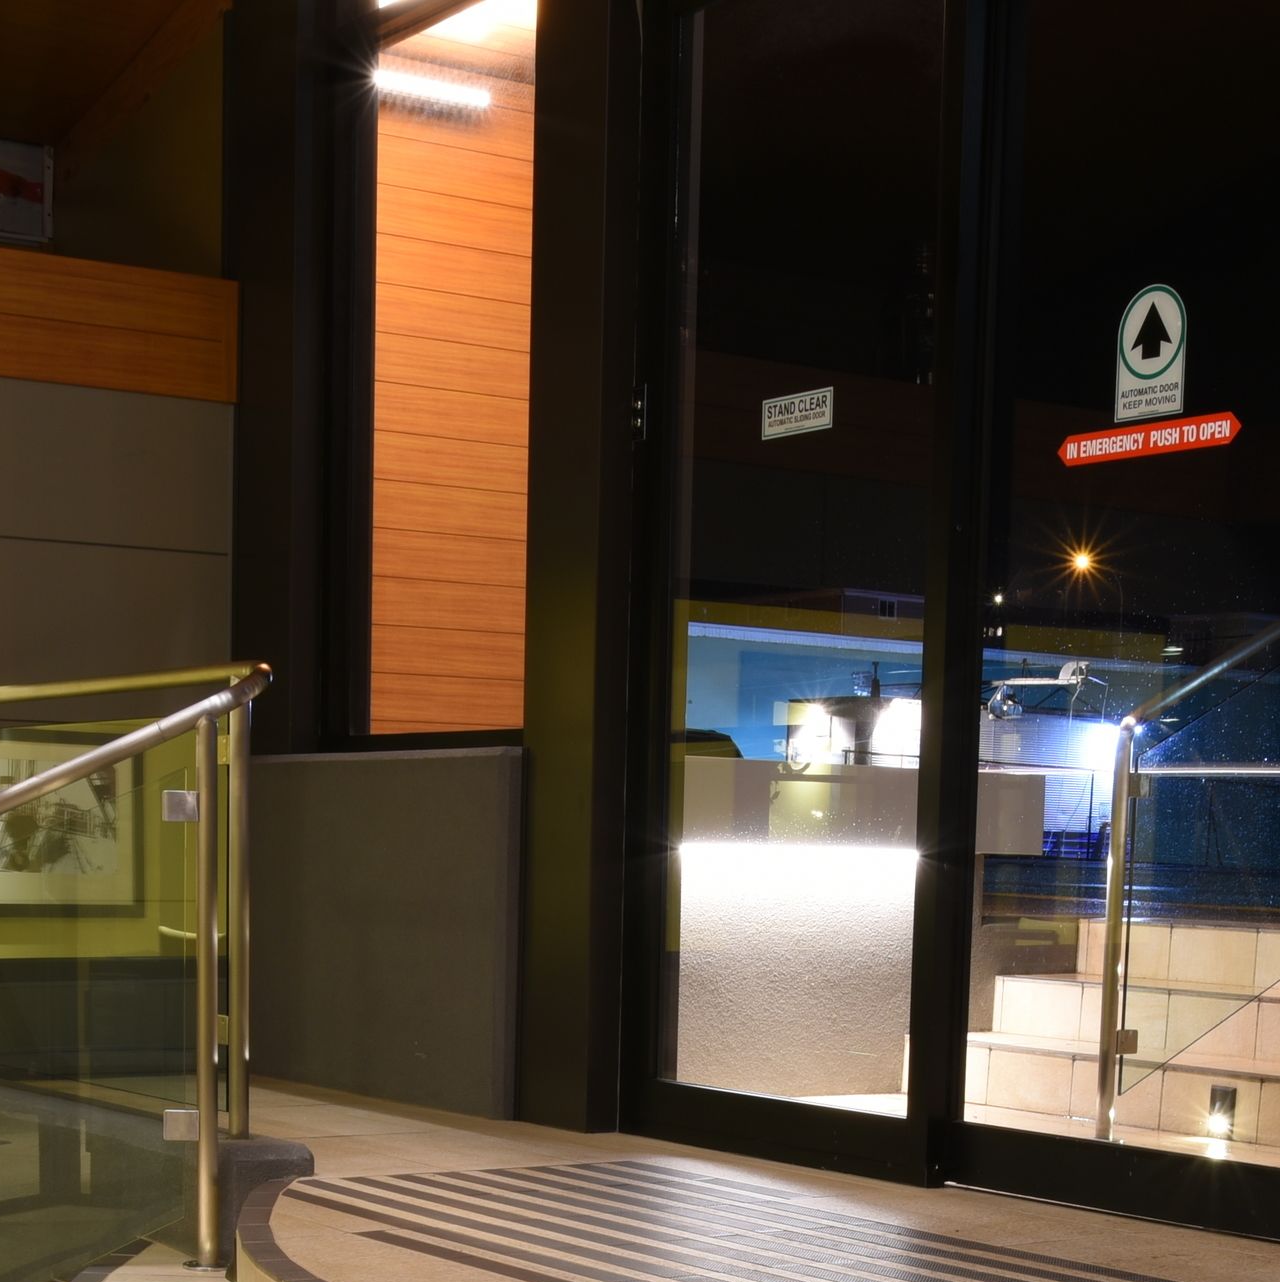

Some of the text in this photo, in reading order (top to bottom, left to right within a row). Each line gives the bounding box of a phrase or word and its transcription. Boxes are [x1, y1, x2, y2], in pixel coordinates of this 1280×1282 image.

[1120, 382, 1179, 400] AUTOMATIC DOOR
[767, 395, 828, 419] STAND CLEAR
[1122, 394, 1177, 411] KEEP MOVING
[1066, 419, 1231, 460] IN EMERGENCY PUSH TO OPEN
